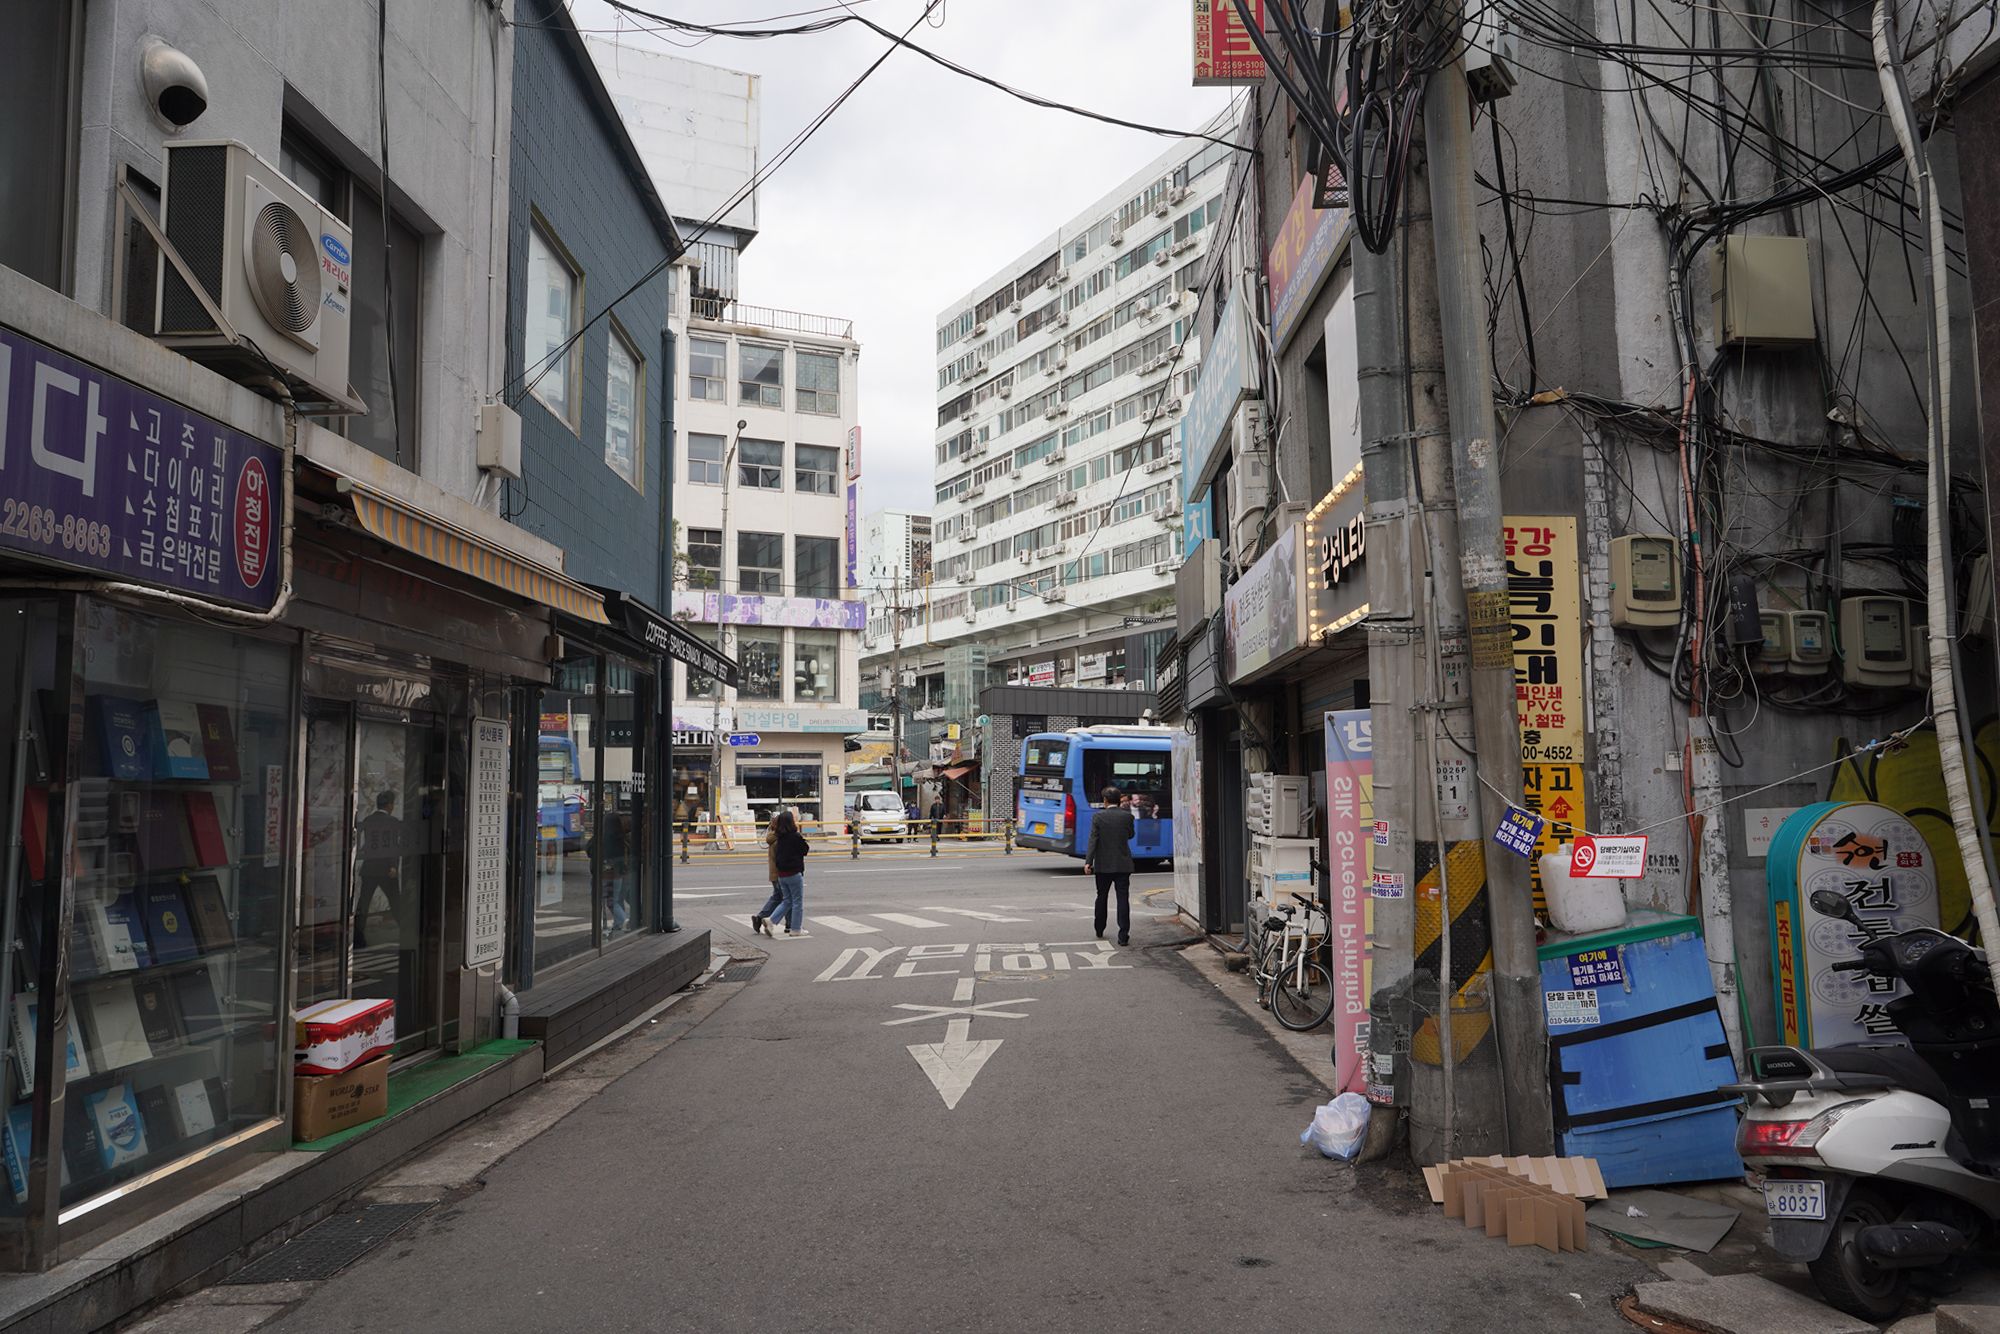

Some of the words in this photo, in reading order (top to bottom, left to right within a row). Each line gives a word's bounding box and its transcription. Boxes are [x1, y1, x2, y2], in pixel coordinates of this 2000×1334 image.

[325, 238, 348, 260] Carrier
[322, 256, 349, 286] 캐리어
[144, 448, 225, 509] 다이어리
[142, 489, 222, 547] 수첩표지
[645, 621, 668, 649] COFFEE
[1452, 682, 1459, 695] 1
[1527, 701, 1562, 712] PVC
[480, 726, 503, 743] 생산품목
[1450, 786, 1457, 799] 1
[1555, 804, 1567, 813] 2F
[1512, 813, 1535, 830] 여기에
[813, 940, 1133, 982] 진입금지
[1579, 950, 1607, 963] 여기에
[1574, 976, 1596, 986] 버리지
[1599, 973, 1621, 983] 마세요
[1778, 919, 1797, 1035] 주차금지
[1547, 992, 1565, 1001] 당일
[330, 1084, 356, 1098] WORLD
[363, 1084, 380, 1096] STAR
[1778, 1196, 1819, 1212] 8037
